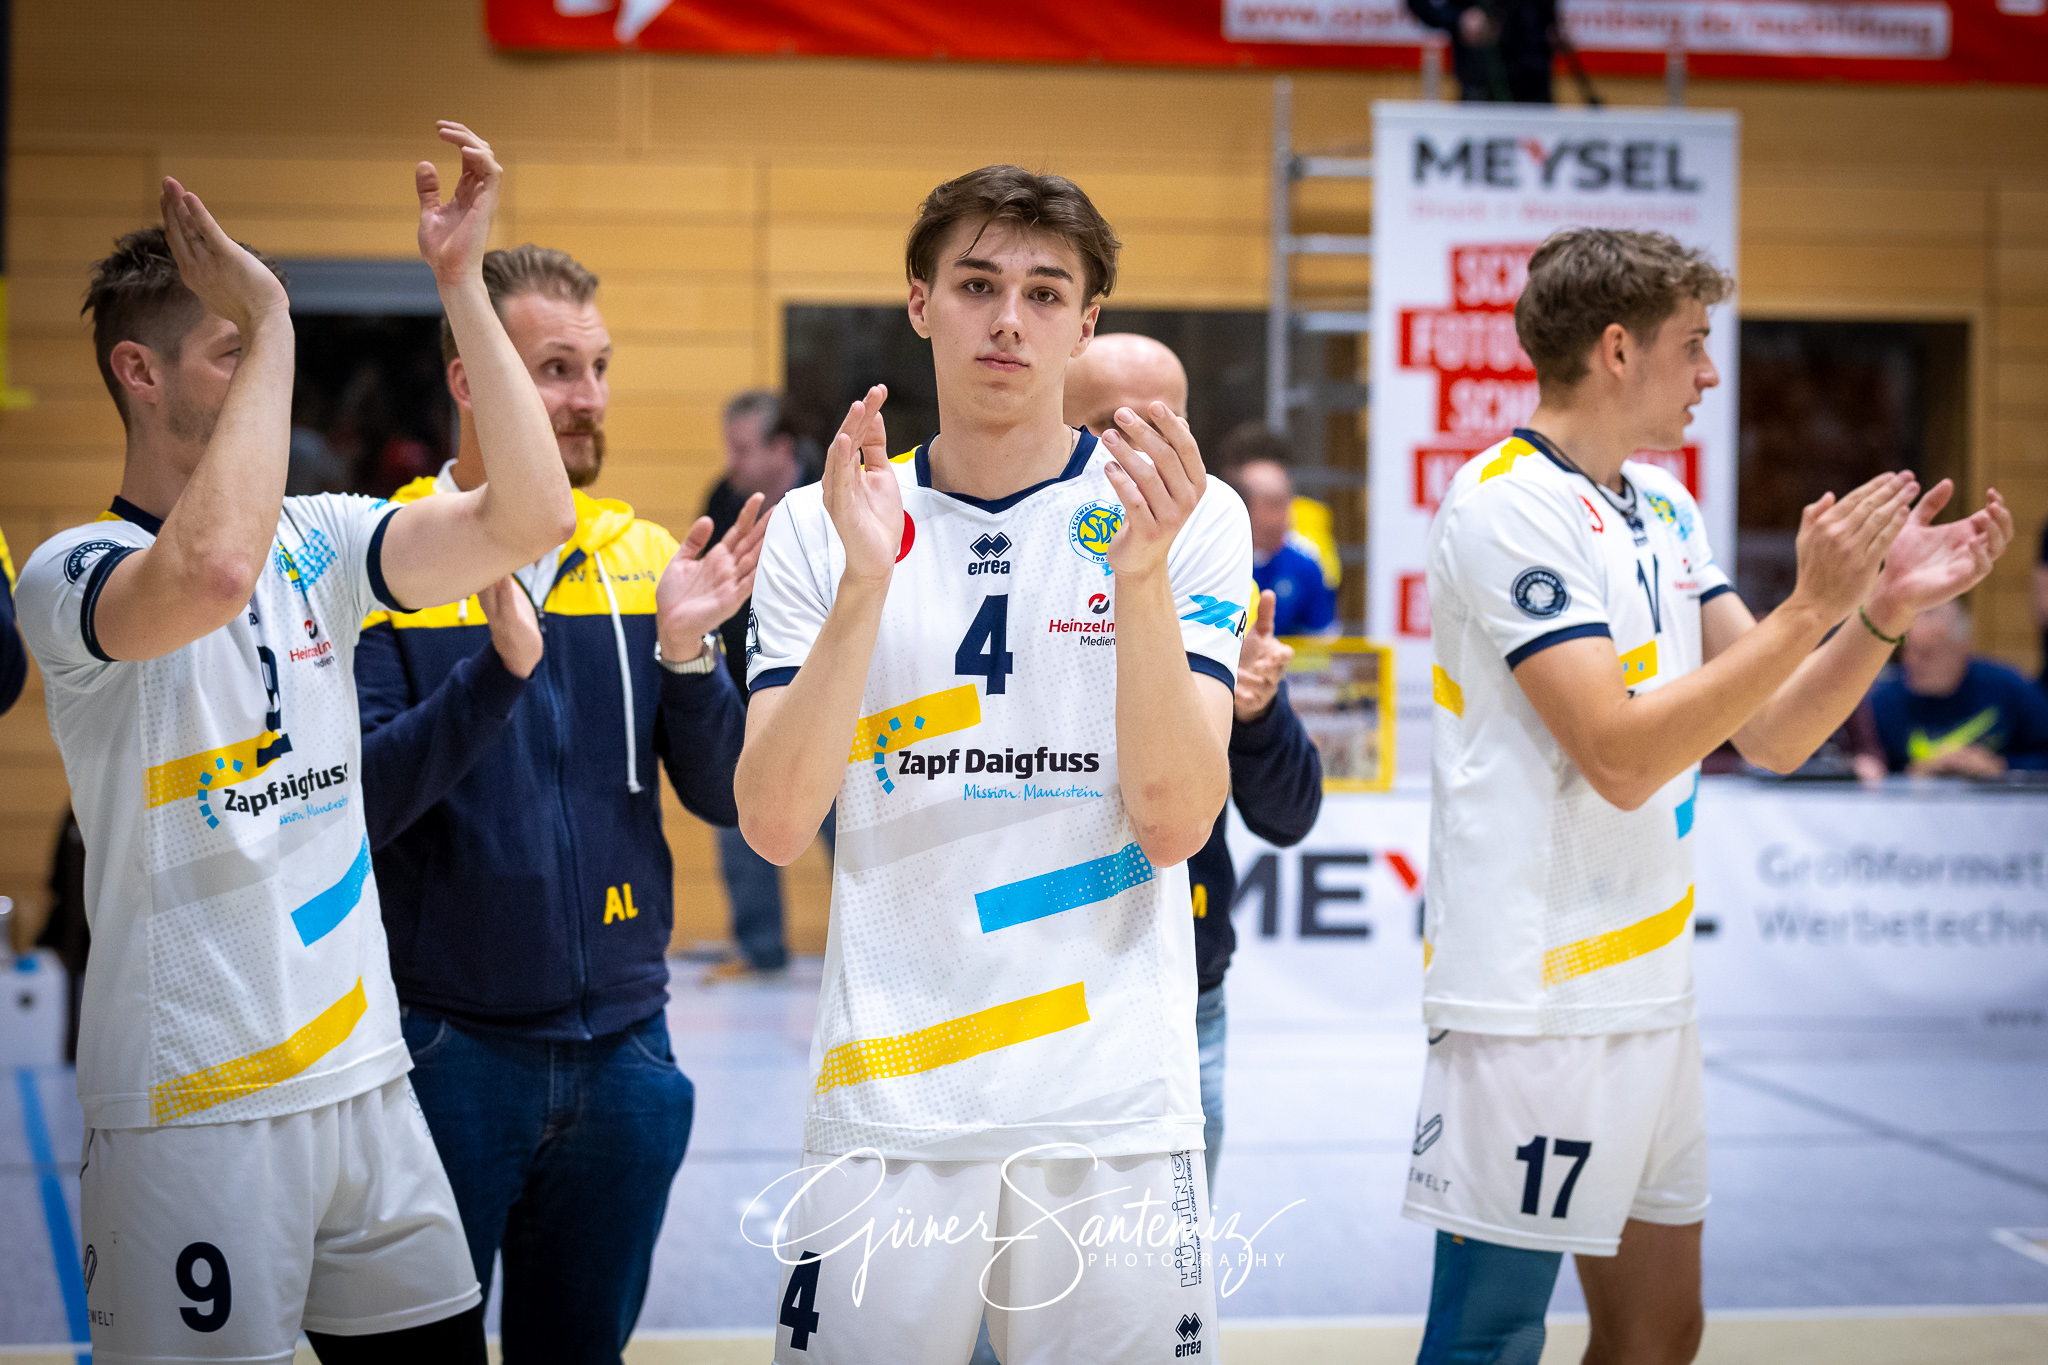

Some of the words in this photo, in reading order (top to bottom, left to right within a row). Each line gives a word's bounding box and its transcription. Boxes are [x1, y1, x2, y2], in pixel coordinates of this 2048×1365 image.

[1412, 134, 1702, 192] MEYSEL
[967, 560, 1011, 575] errea
[955, 593, 1013, 695] 4
[899, 748, 960, 780] Zapf
[965, 747, 1100, 779] Daigfuss
[224, 781, 279, 817] Zapf
[603, 883, 639, 925] AL
[1516, 1135, 1593, 1219] 17
[175, 1241, 232, 1333] 9
[779, 1251, 822, 1352] 4
[1175, 1340, 1202, 1358] errea
